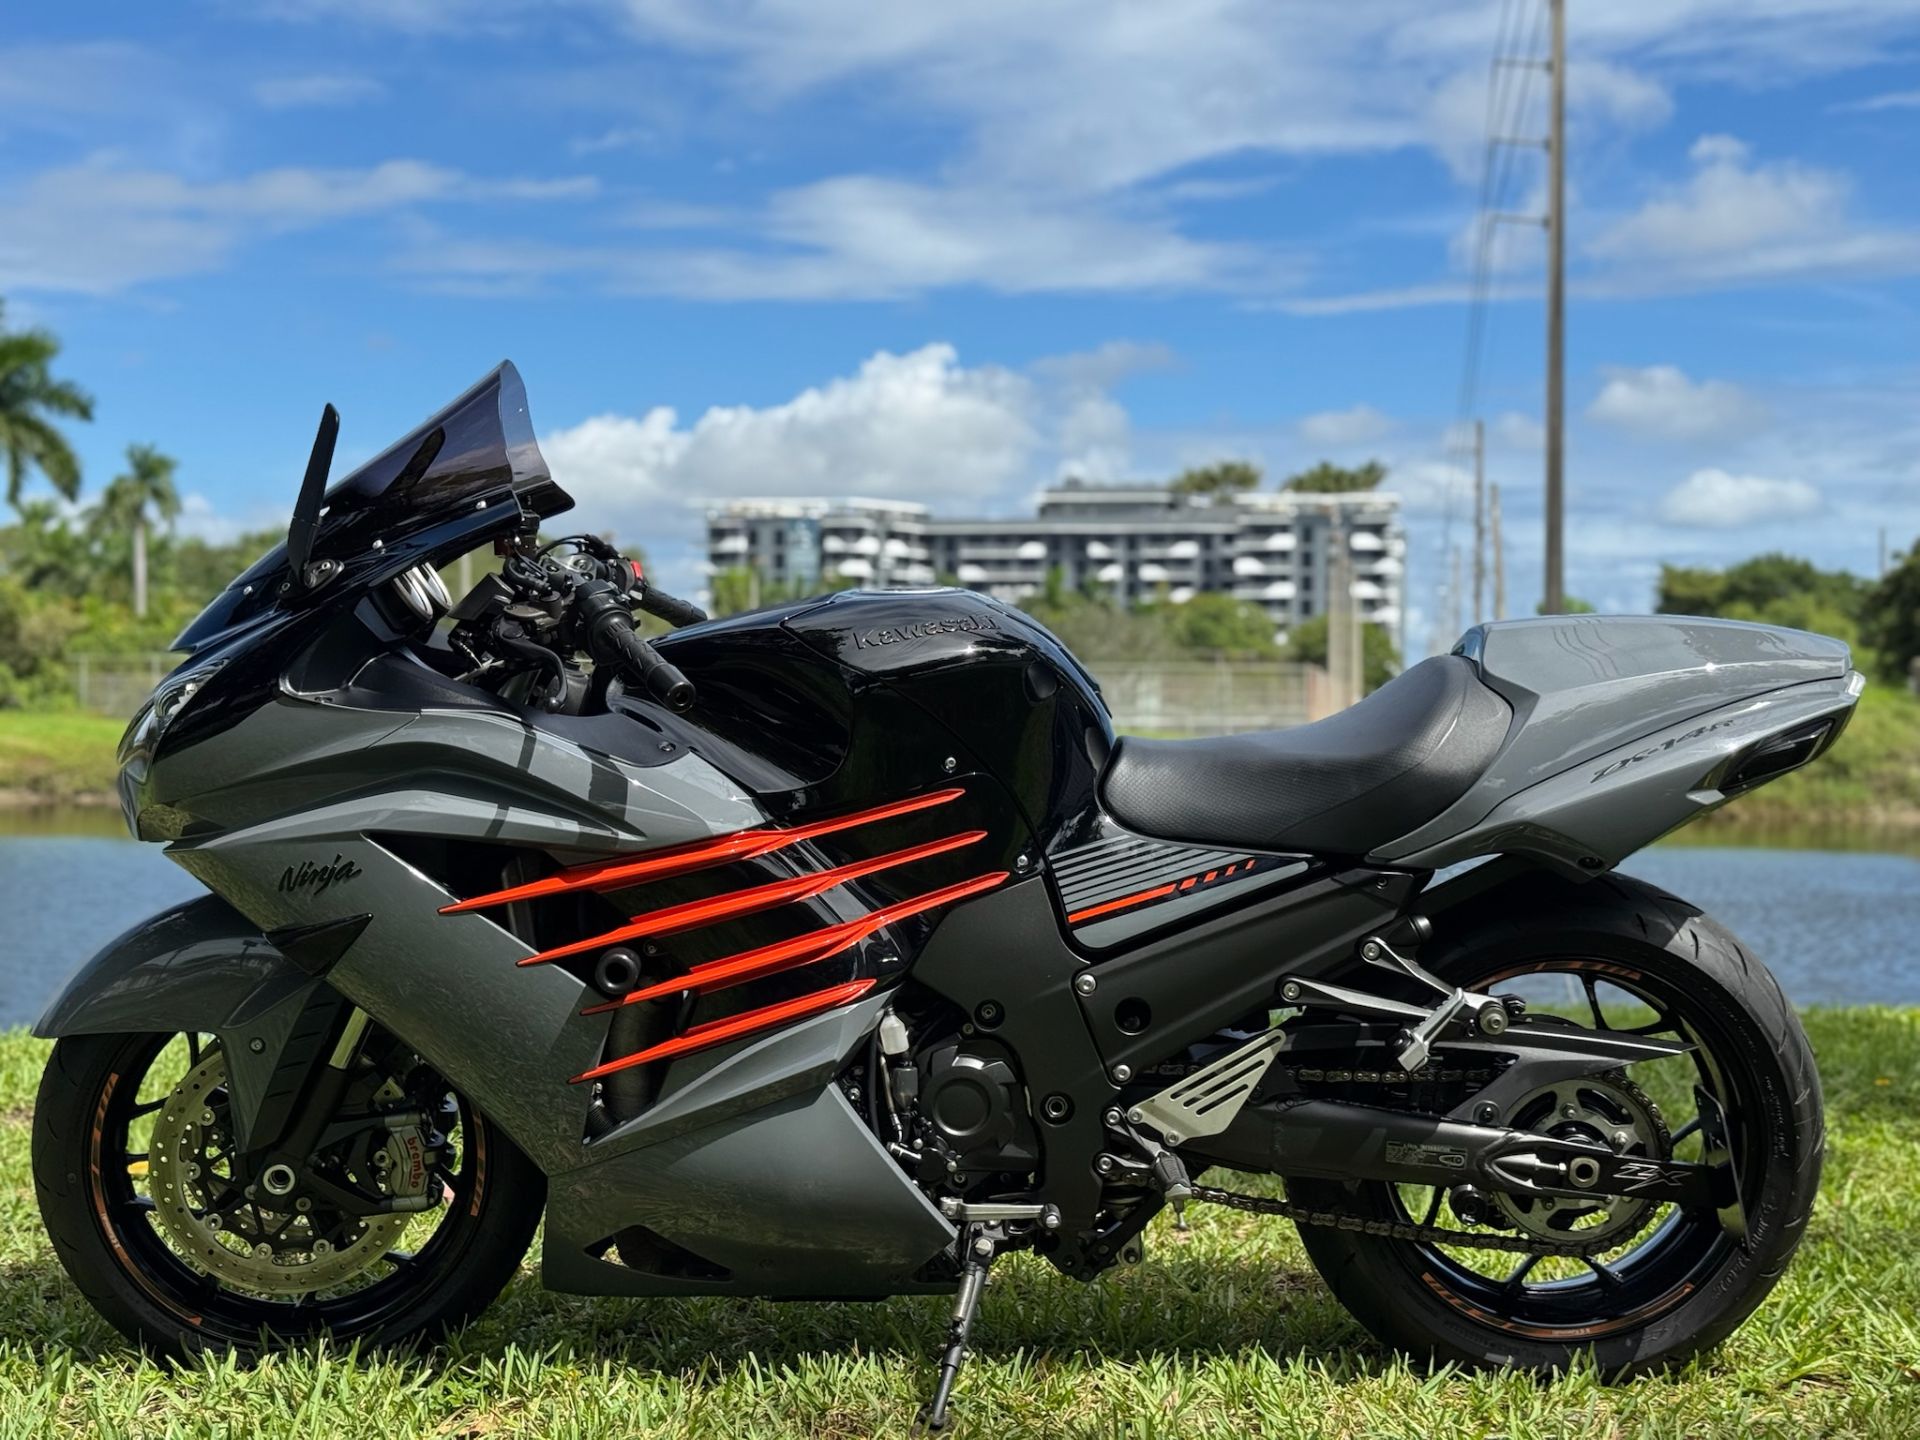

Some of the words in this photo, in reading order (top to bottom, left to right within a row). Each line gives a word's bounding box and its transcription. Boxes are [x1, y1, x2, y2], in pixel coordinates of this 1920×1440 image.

[853, 615, 1000, 650] Kawasaki
[278, 853, 363, 896] Ninja
[407, 1136, 424, 1188] brembo
[1613, 1162, 1693, 1192] ZX
